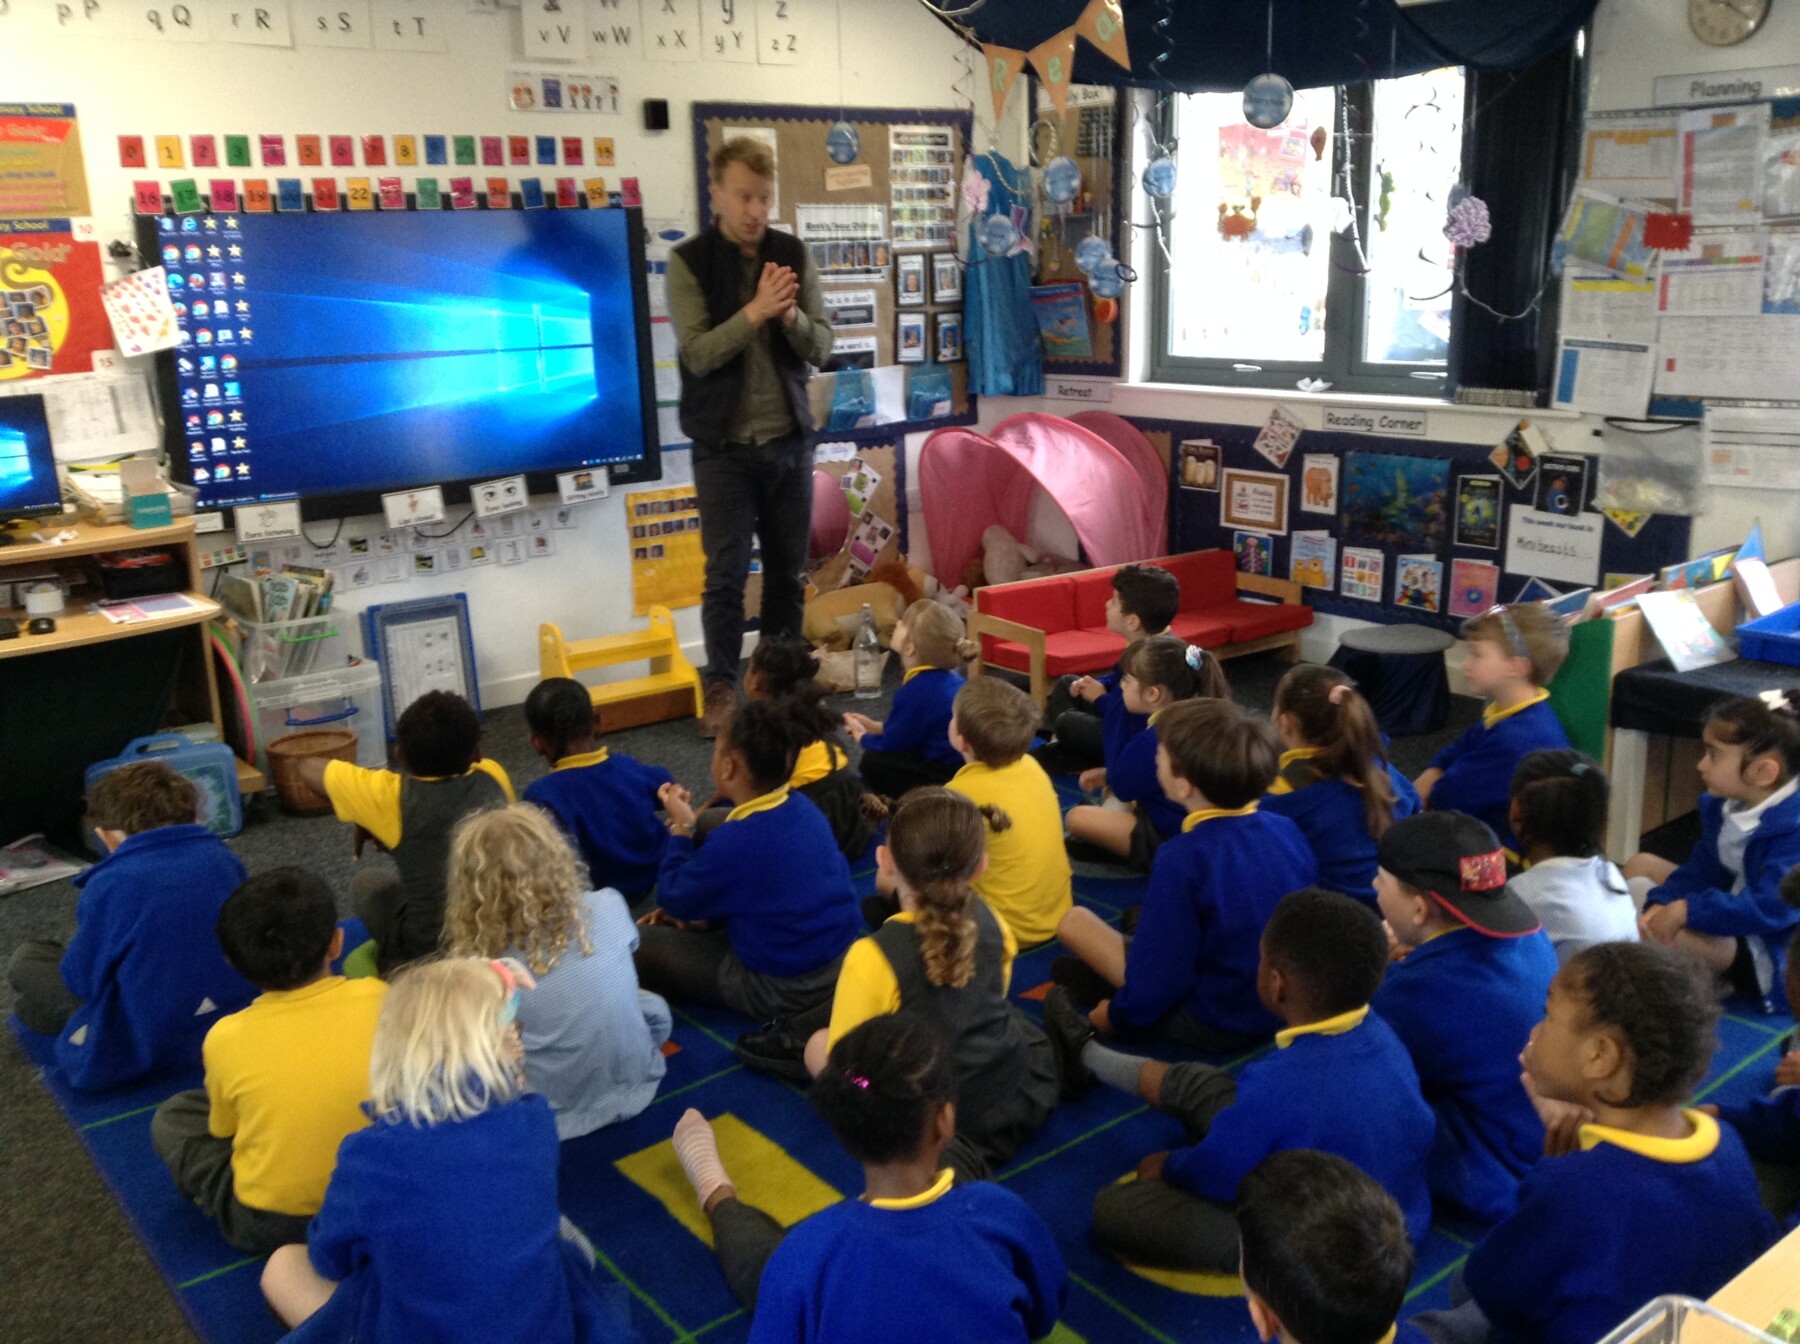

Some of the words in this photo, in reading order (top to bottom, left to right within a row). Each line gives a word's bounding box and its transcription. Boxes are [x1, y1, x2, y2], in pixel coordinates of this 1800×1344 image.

[1690, 78, 1762, 99] Planning
[165, 146, 174, 159] 1
[233, 145, 243, 159] 3
[350, 187, 368, 201] 22
[14, 221, 49, 232] School
[1058, 385, 1092, 398] Retreat
[1327, 412, 1374, 431] Reading
[1379, 415, 1423, 430] Corner
